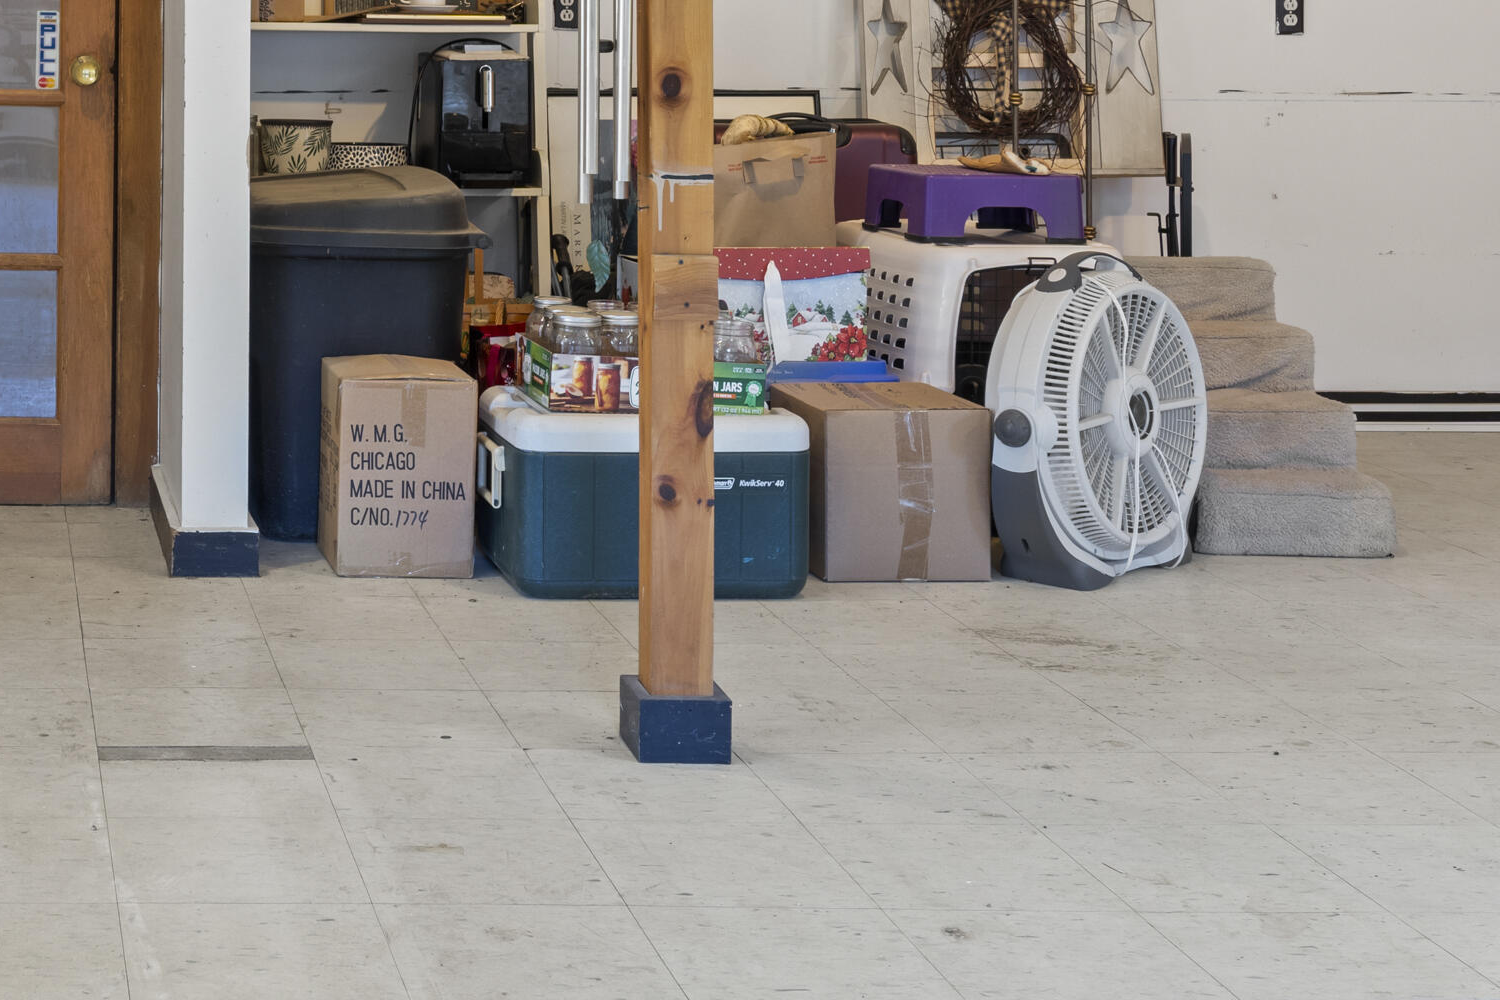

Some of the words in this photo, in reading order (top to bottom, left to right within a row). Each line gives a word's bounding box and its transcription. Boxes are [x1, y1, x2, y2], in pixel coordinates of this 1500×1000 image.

[39, 24, 56, 76] PULL
[573, 214, 582, 257] MARK
[720, 381, 743, 393] JARS
[350, 451, 416, 471] CHICAGO
[350, 479, 394, 499] MADE
[401, 480, 416, 500] IN
[422, 480, 466, 501] CHINA
[775, 479, 785, 487] 40
[350, 507, 393, 527] C/NO.
